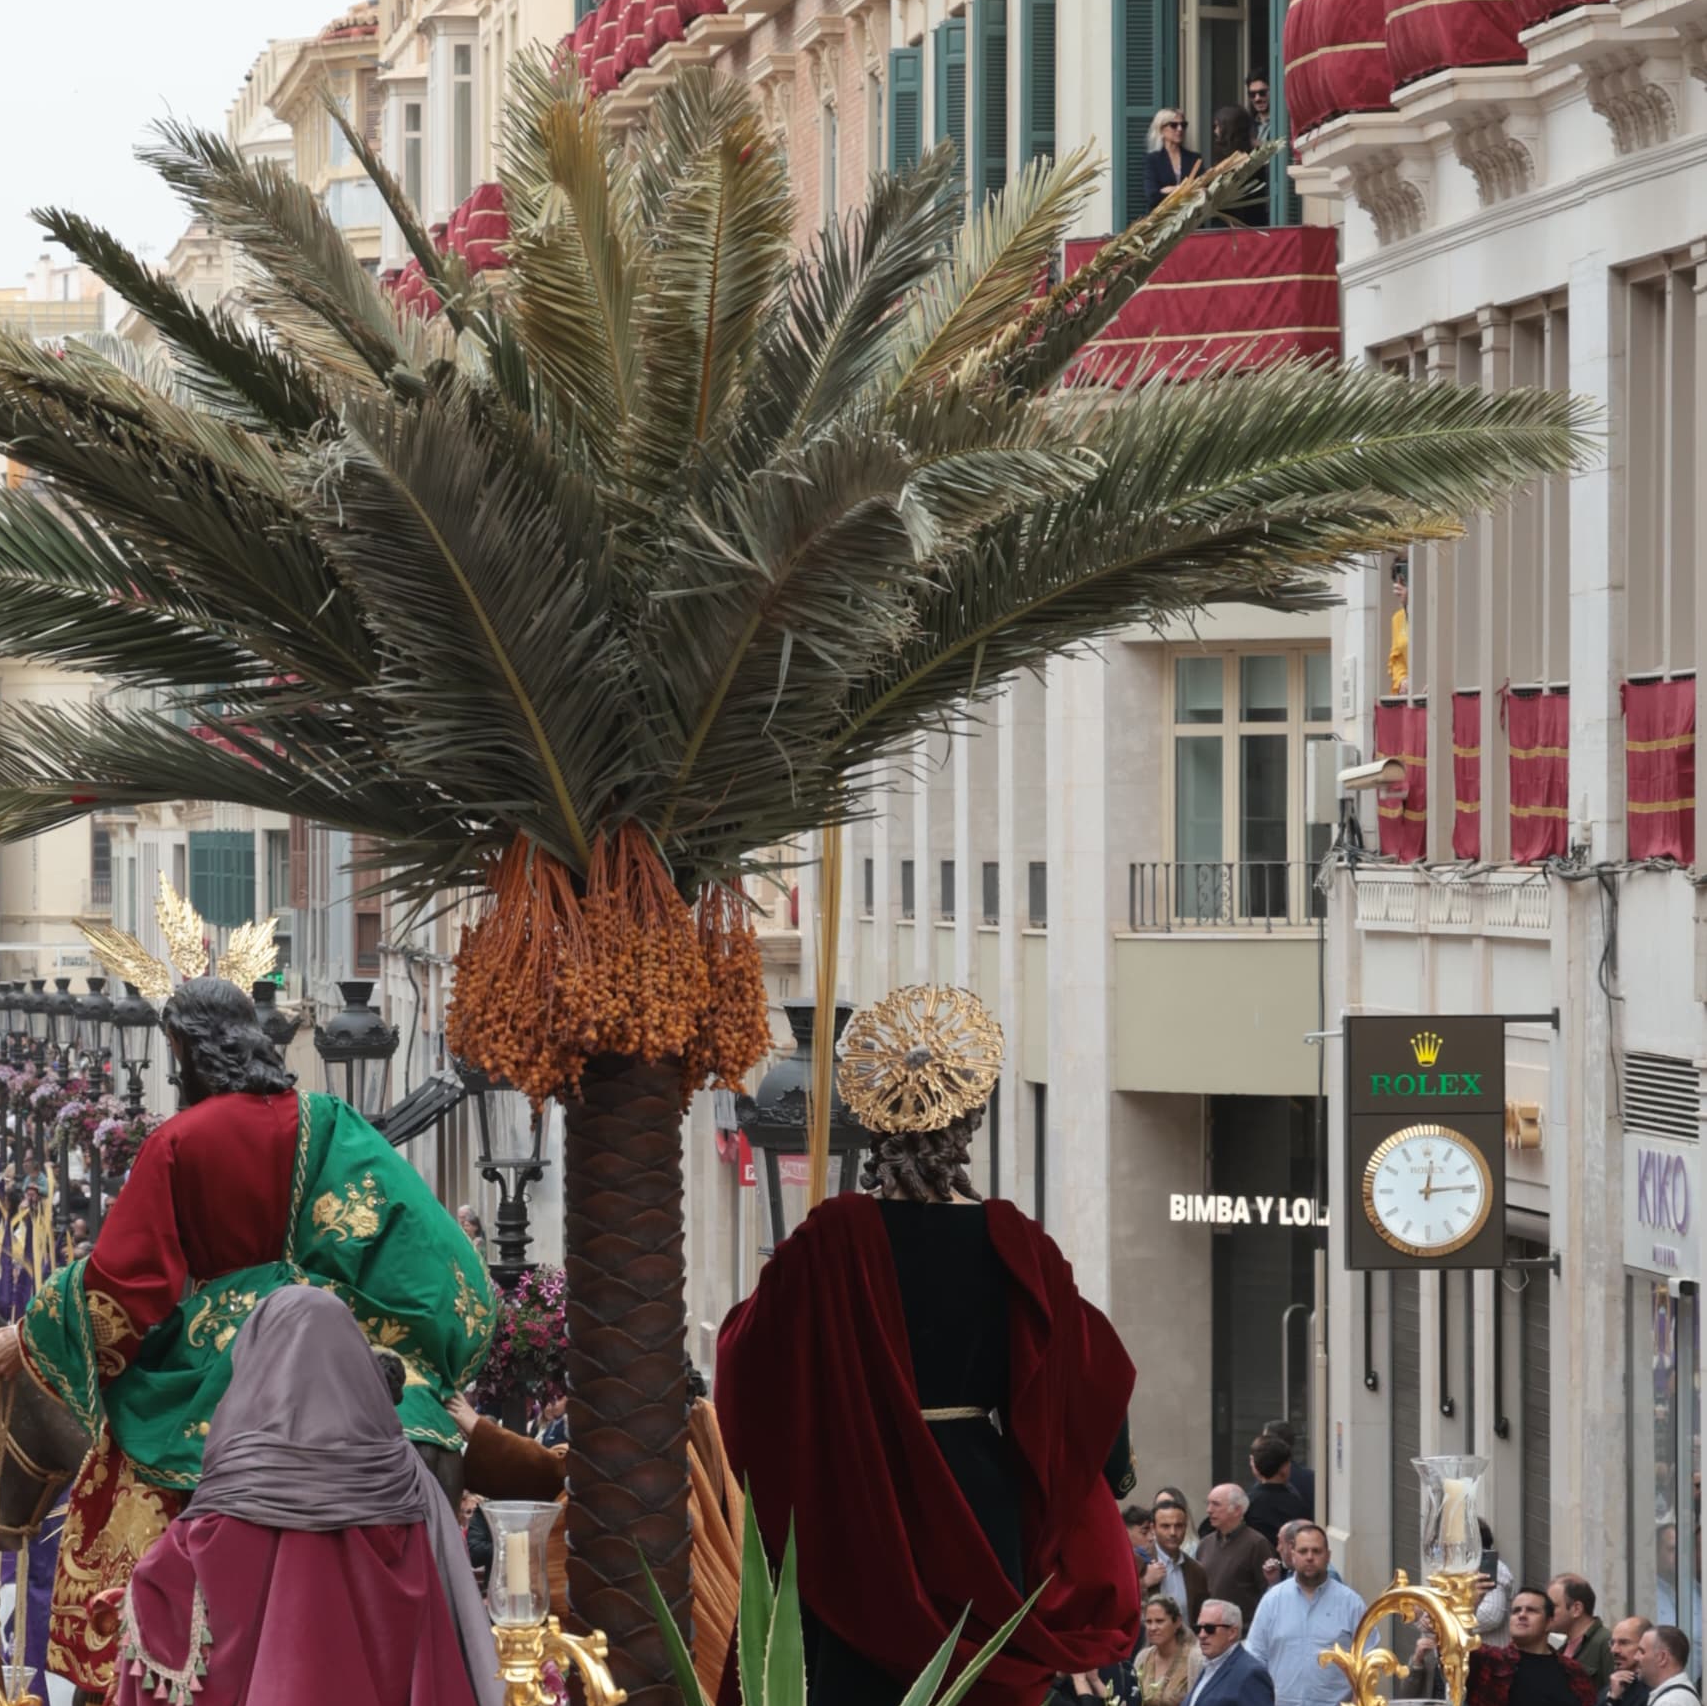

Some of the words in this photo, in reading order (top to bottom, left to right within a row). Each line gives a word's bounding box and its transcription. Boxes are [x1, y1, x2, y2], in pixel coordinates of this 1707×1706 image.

[1369, 1073, 1483, 1096] ROLEX
[1637, 1148, 1690, 1236] KIKO
[1169, 1193, 1252, 1224] BIMBA
[1255, 1195, 1275, 1225] Y
